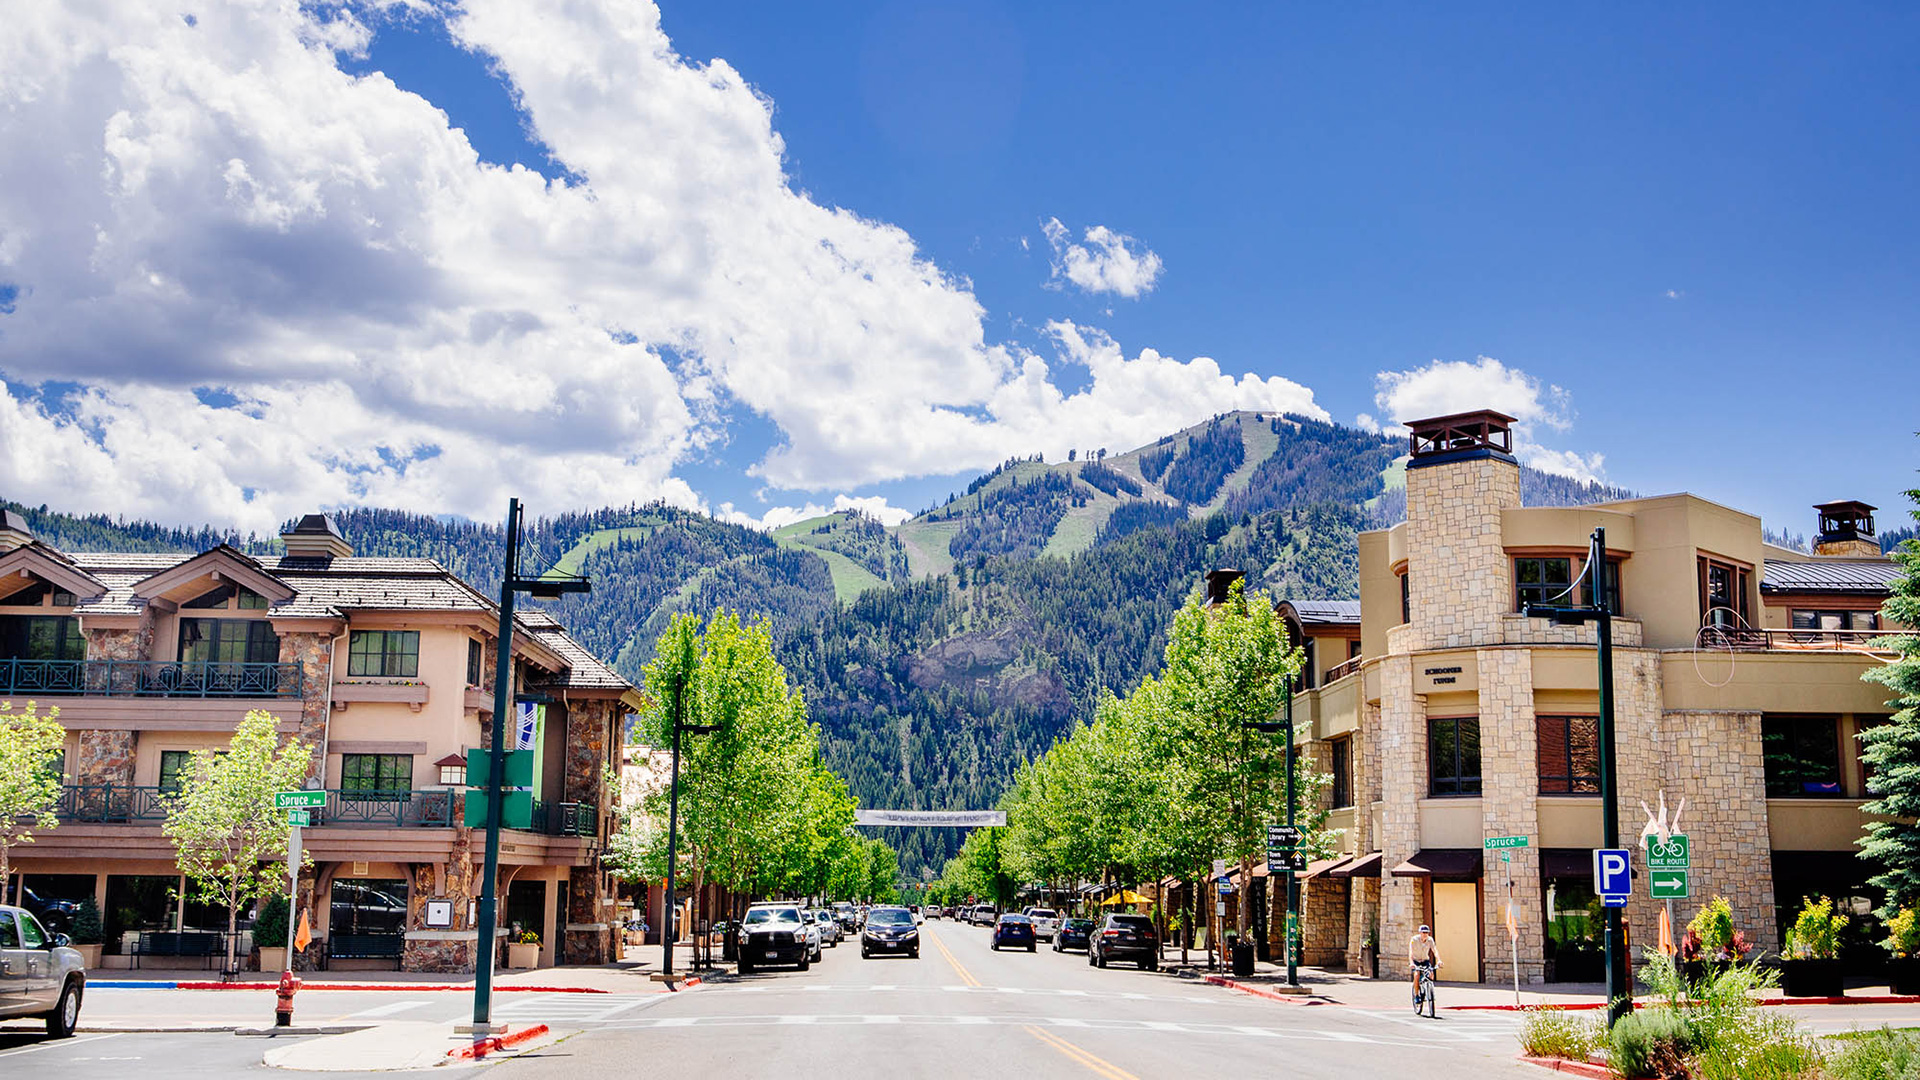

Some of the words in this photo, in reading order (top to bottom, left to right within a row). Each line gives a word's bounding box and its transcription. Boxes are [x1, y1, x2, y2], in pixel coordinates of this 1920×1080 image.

[280, 795, 309, 807] Spruce
[1486, 838, 1515, 848] Spruce
[1602, 855, 1625, 889] P
[1255, 885, 1263, 931] GALLERY
